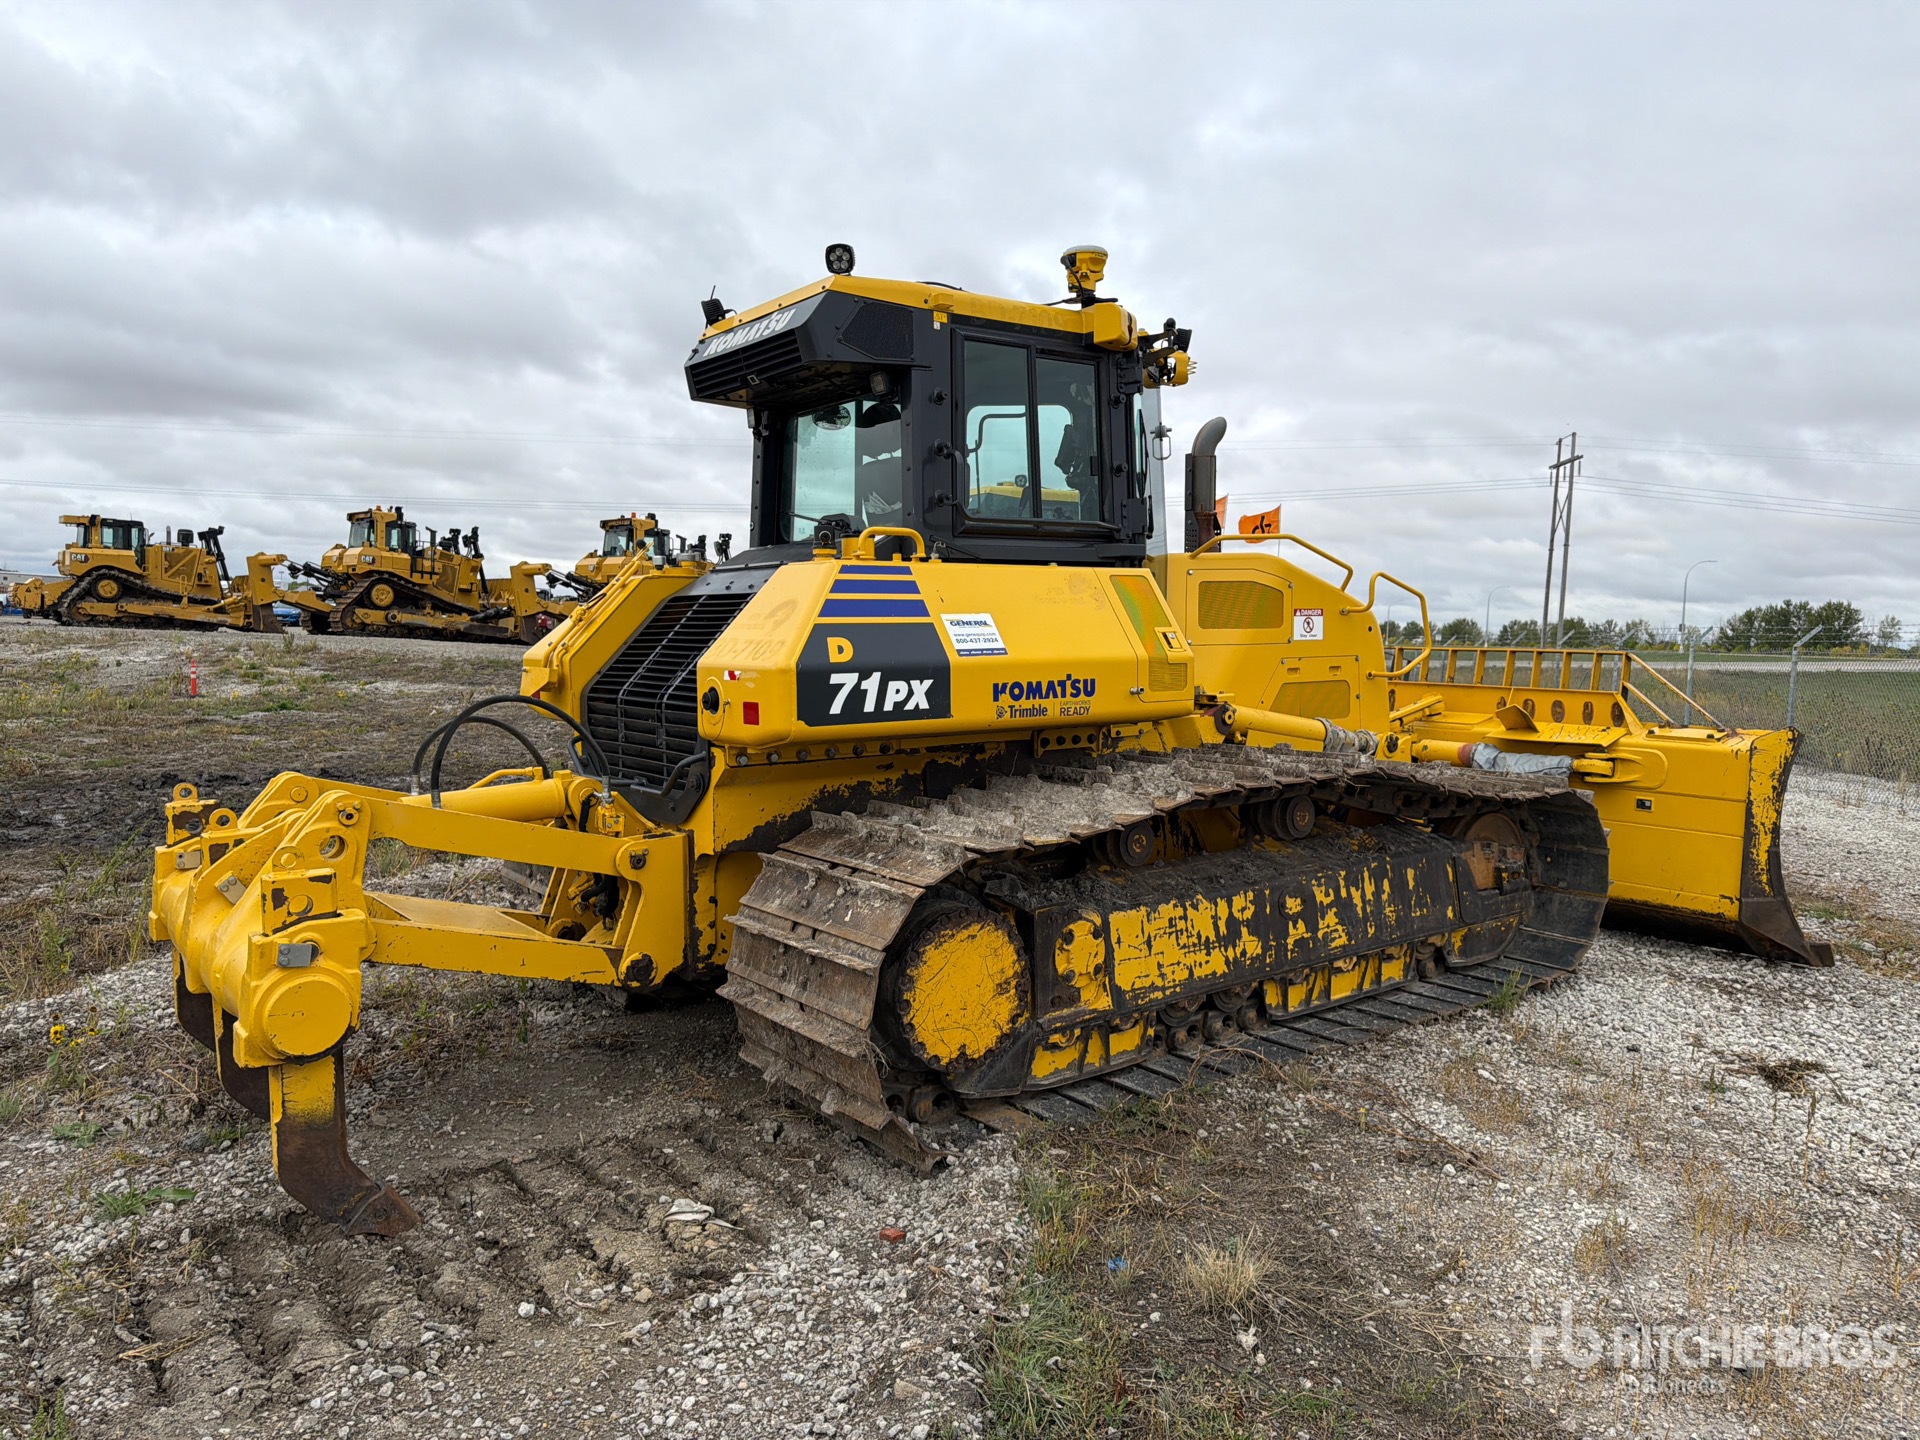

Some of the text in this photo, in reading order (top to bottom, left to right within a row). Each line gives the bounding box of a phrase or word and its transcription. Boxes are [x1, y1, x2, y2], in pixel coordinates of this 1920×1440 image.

[703, 308, 797, 358] KOMATSU
[71, 554, 86, 562] CAT
[361, 555, 374, 564] CAT
[950, 619, 990, 628] GENERAL
[826, 636, 854, 663] D
[829, 671, 934, 715] 71PX
[992, 673, 1096, 702] KOMATSU
[1060, 699, 1091, 707] EARTHWORKS
[1008, 703, 1048, 719] Trimble
[1060, 706, 1091, 717] READY
